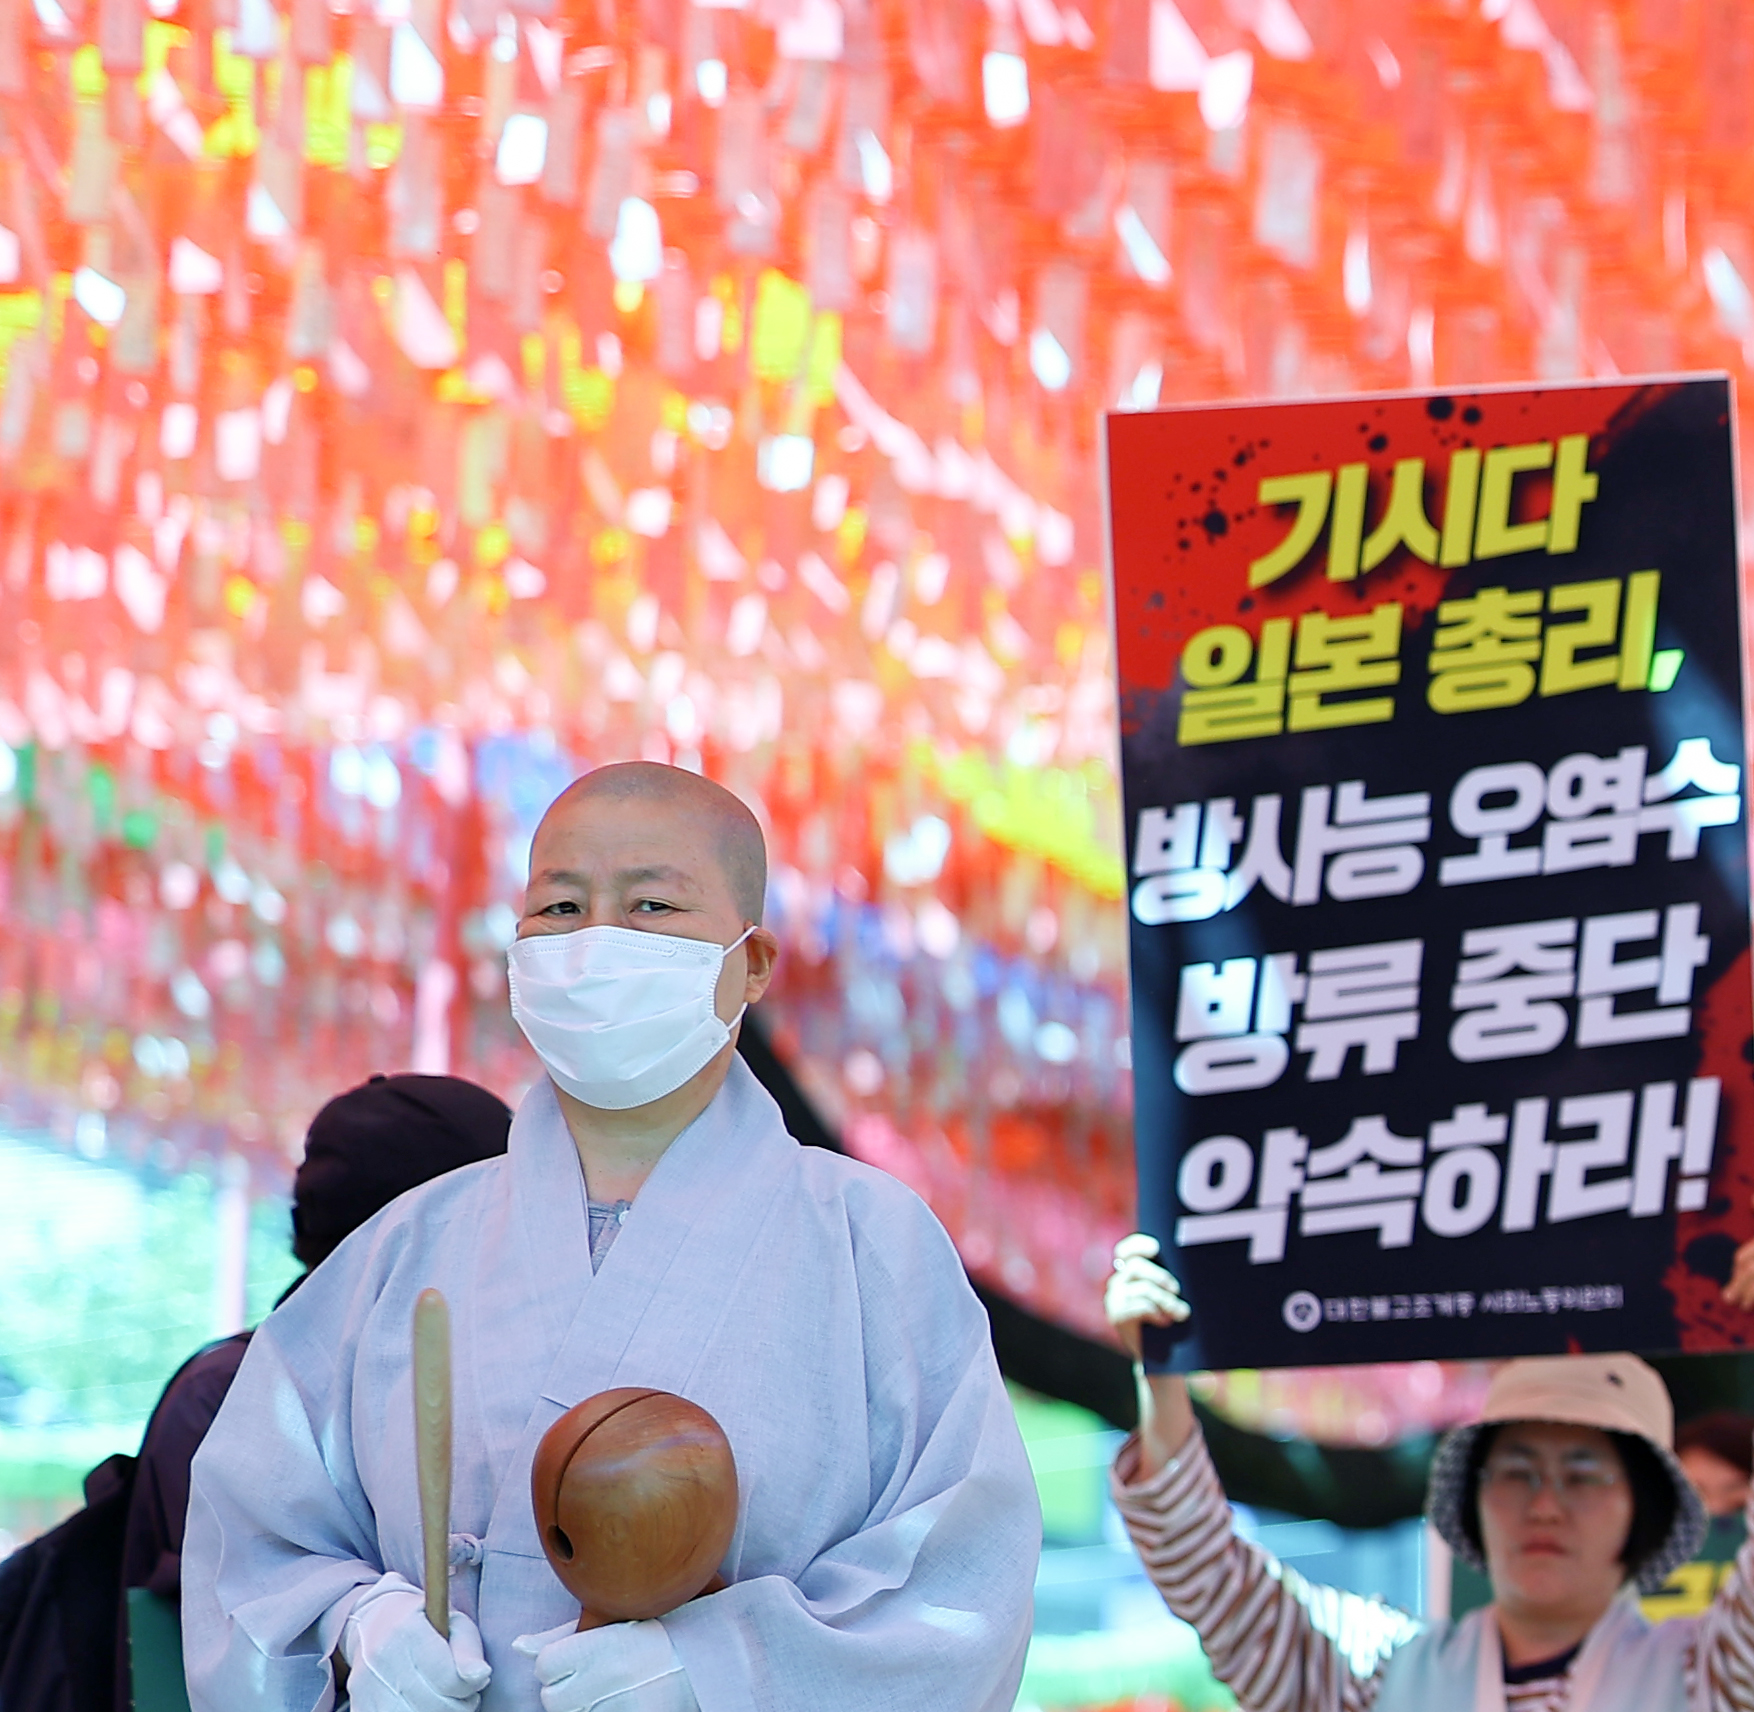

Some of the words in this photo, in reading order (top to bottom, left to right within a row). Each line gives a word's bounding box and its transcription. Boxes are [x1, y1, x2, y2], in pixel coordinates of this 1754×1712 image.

[1249, 434, 1597, 588] 기시다
[1179, 605, 1401, 745] 일본
[1428, 571, 1684, 714] 총리,
[1133, 782, 1429, 924] 방사능
[1440, 738, 1741, 884] 오염수
[1174, 942, 1423, 1095] 방류
[1450, 905, 1709, 1060] 중단
[1176, 1077, 1720, 1262] 약속하라!
